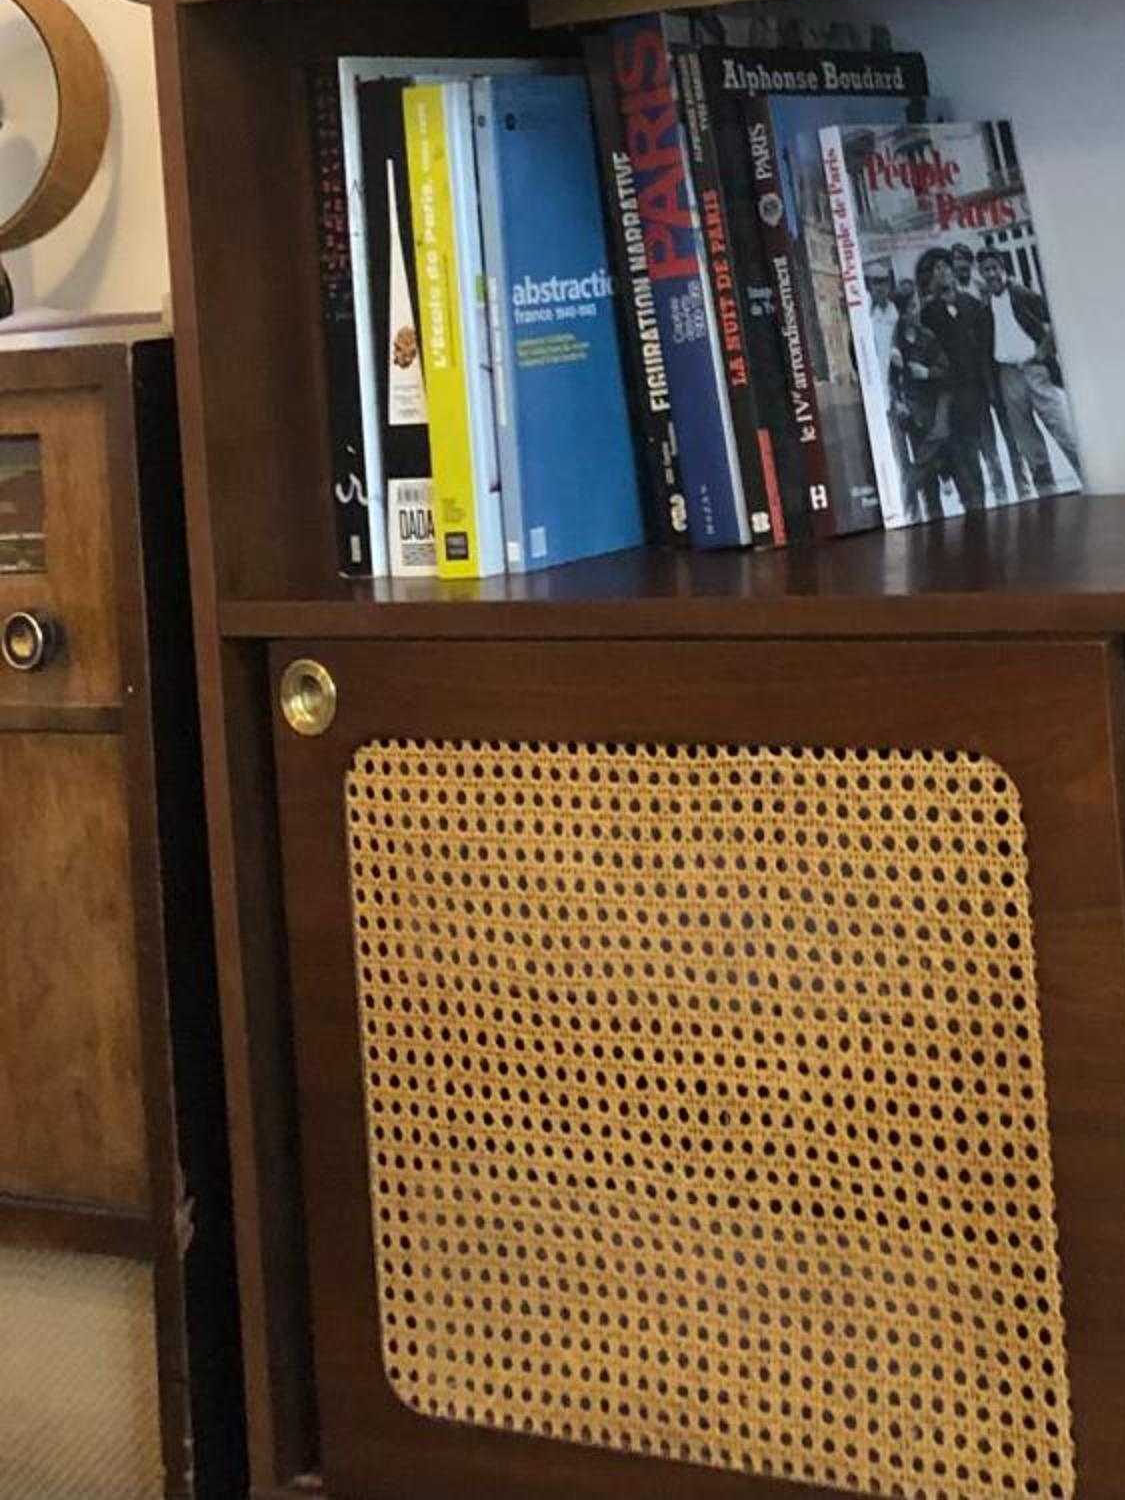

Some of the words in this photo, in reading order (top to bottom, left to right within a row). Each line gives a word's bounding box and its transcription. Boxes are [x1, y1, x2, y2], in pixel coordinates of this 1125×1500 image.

[722, 58, 818, 96] Alphonse
[822, 61, 905, 90] Boudard
[616, 32, 696, 280] PARIS
[748, 121, 773, 181] PARIS
[825, 147, 845, 197] Paris
[864, 148, 961, 197] Peuple
[613, 151, 646, 273] NARRATIVE
[703, 189, 727, 253] PARIS
[831, 198, 848, 219] de
[934, 191, 1017, 231] Paris
[713, 257, 732, 289] DE
[835, 222, 860, 282] Peuple
[632, 278, 671, 411] FIGURATION
[718, 296, 741, 351] NUIT
[771, 255, 807, 390] arrondissement
[727, 356, 748, 387] LA
[797, 423, 816, 442] le
[398, 509, 436, 542] DADA
